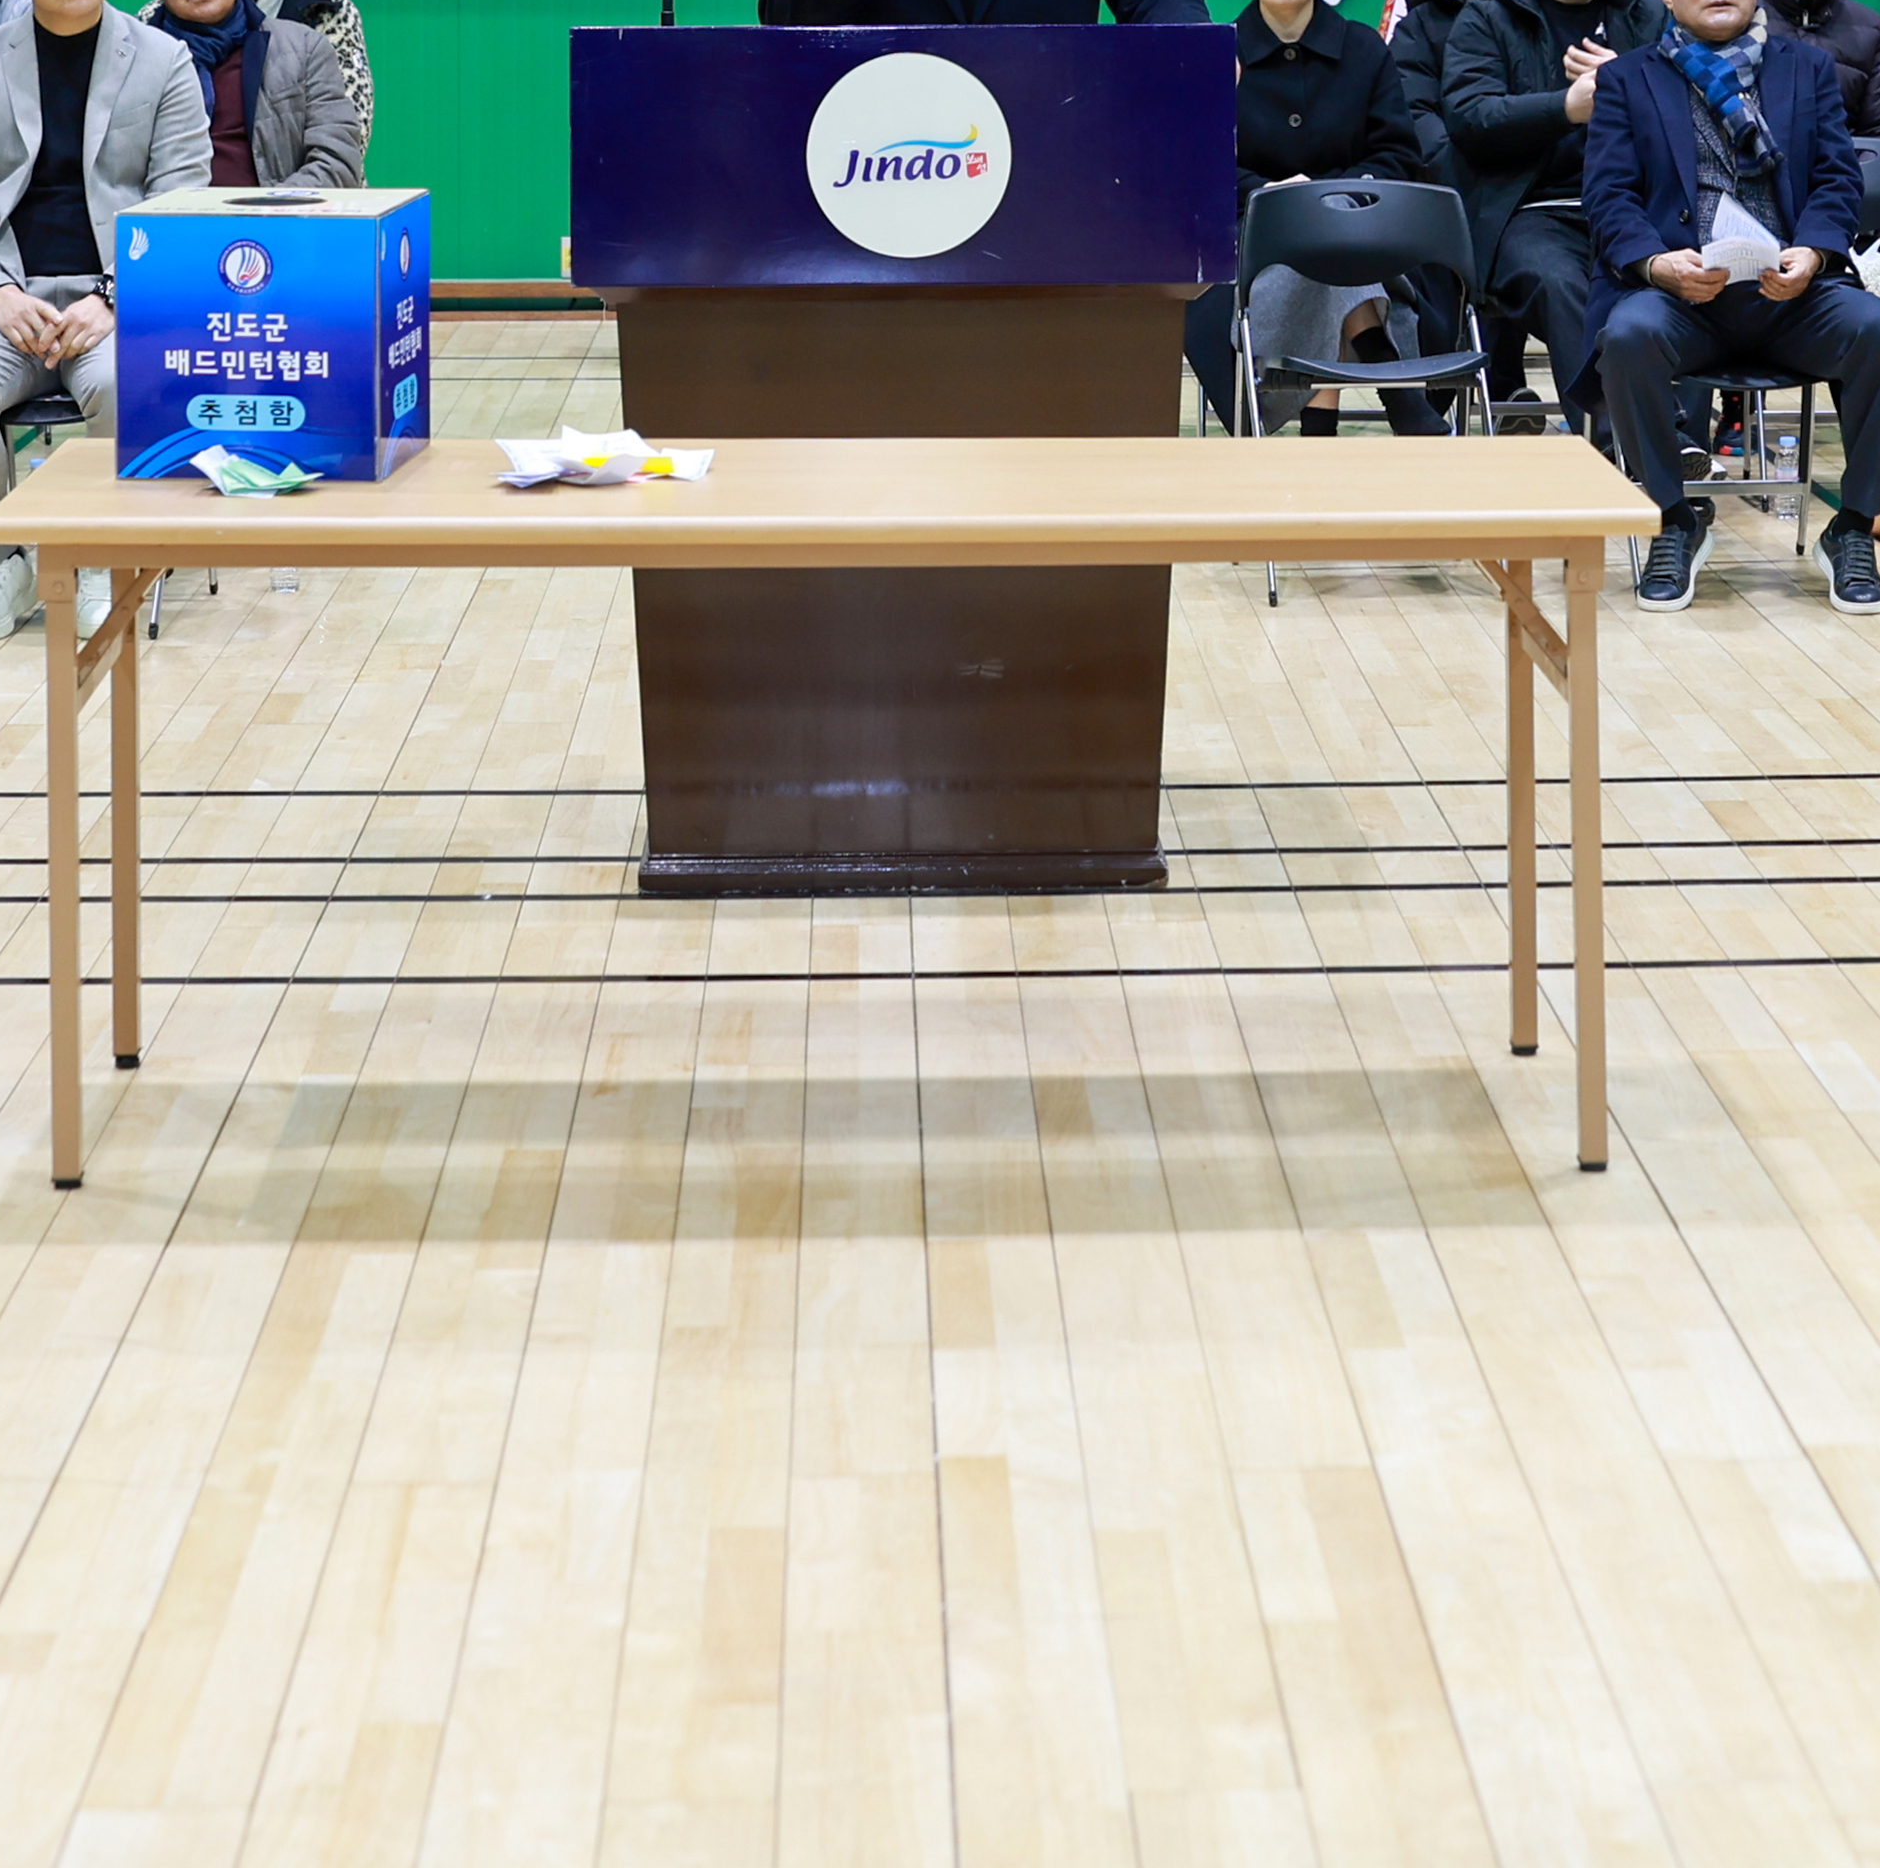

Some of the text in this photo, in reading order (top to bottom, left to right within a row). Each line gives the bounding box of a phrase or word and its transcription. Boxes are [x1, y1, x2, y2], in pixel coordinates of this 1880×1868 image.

[832, 146, 962, 188] Jindo
[206, 310, 289, 344] 진도군
[163, 349, 330, 383] 배드민턴협회
